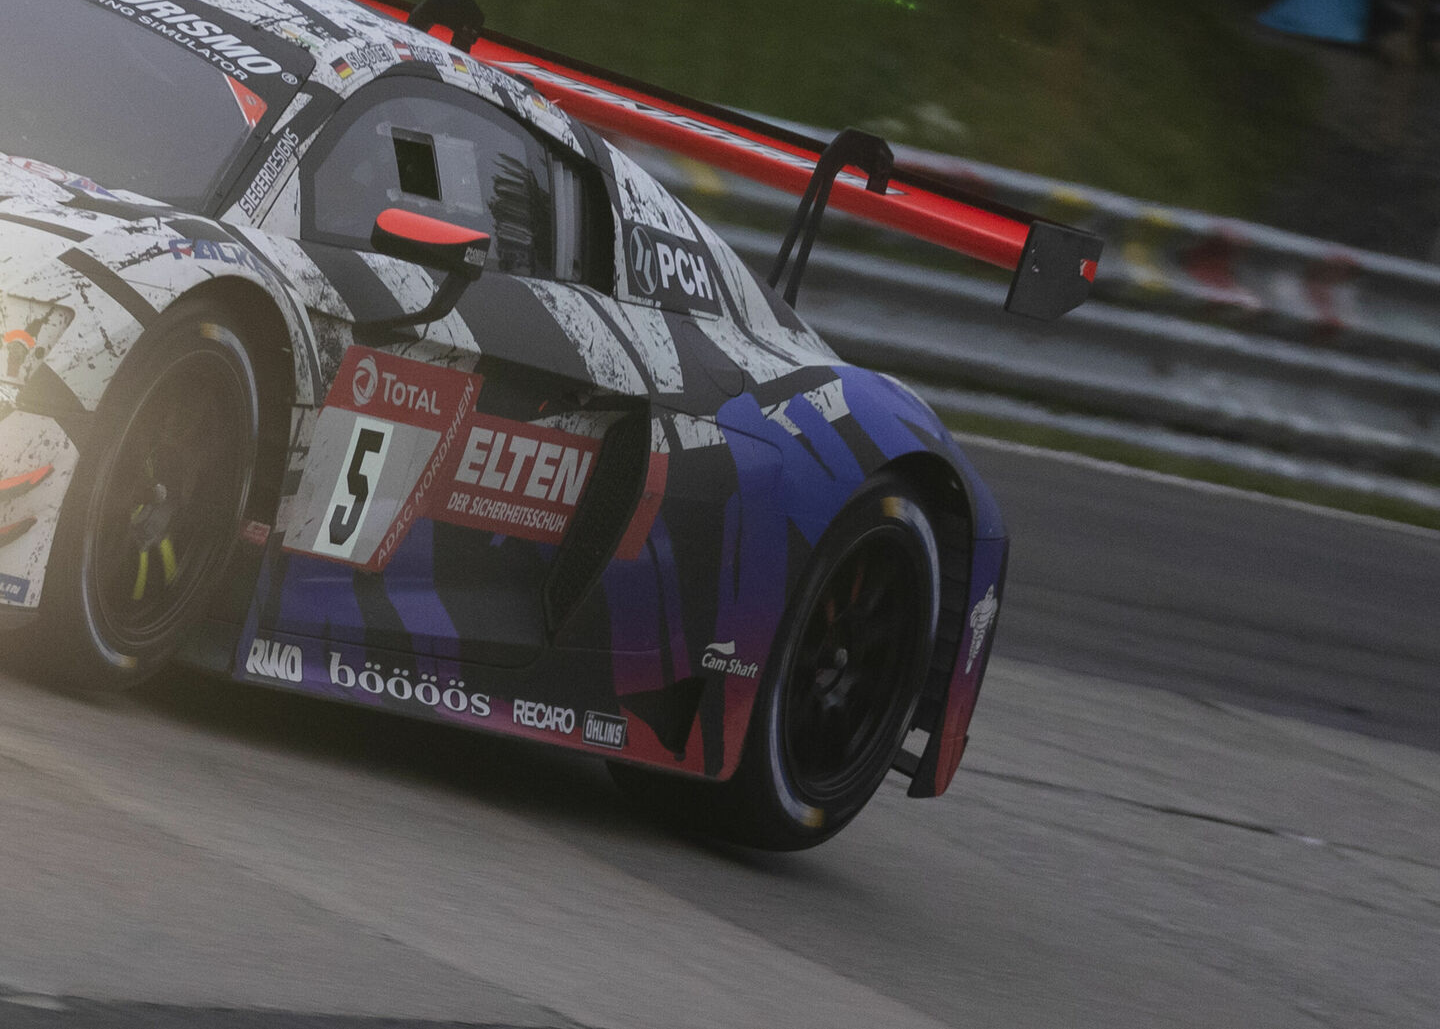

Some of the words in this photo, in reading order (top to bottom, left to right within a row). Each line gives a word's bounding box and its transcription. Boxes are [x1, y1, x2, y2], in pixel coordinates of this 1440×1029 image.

[138, 15, 249, 81] SIMULATOR
[239, 126, 300, 219] SIEGERDESIGNS
[656, 242, 714, 301] PCH
[382, 372, 441, 415] TOTAL
[329, 427, 385, 546] 5
[377, 504, 412, 565] ADAC
[415, 377, 476, 505] NORDRHEIN
[454, 426, 594, 506] ELTEN
[447, 491, 471, 513] DER
[468, 496, 568, 533] SICHERHEITSSCHUH
[329, 652, 491, 717] böööös
[701, 652, 727, 672] Cam
[726, 658, 759, 679] Shaft
[513, 698, 576, 735] RECARO
[585, 714, 624, 745] ÖHLINS
